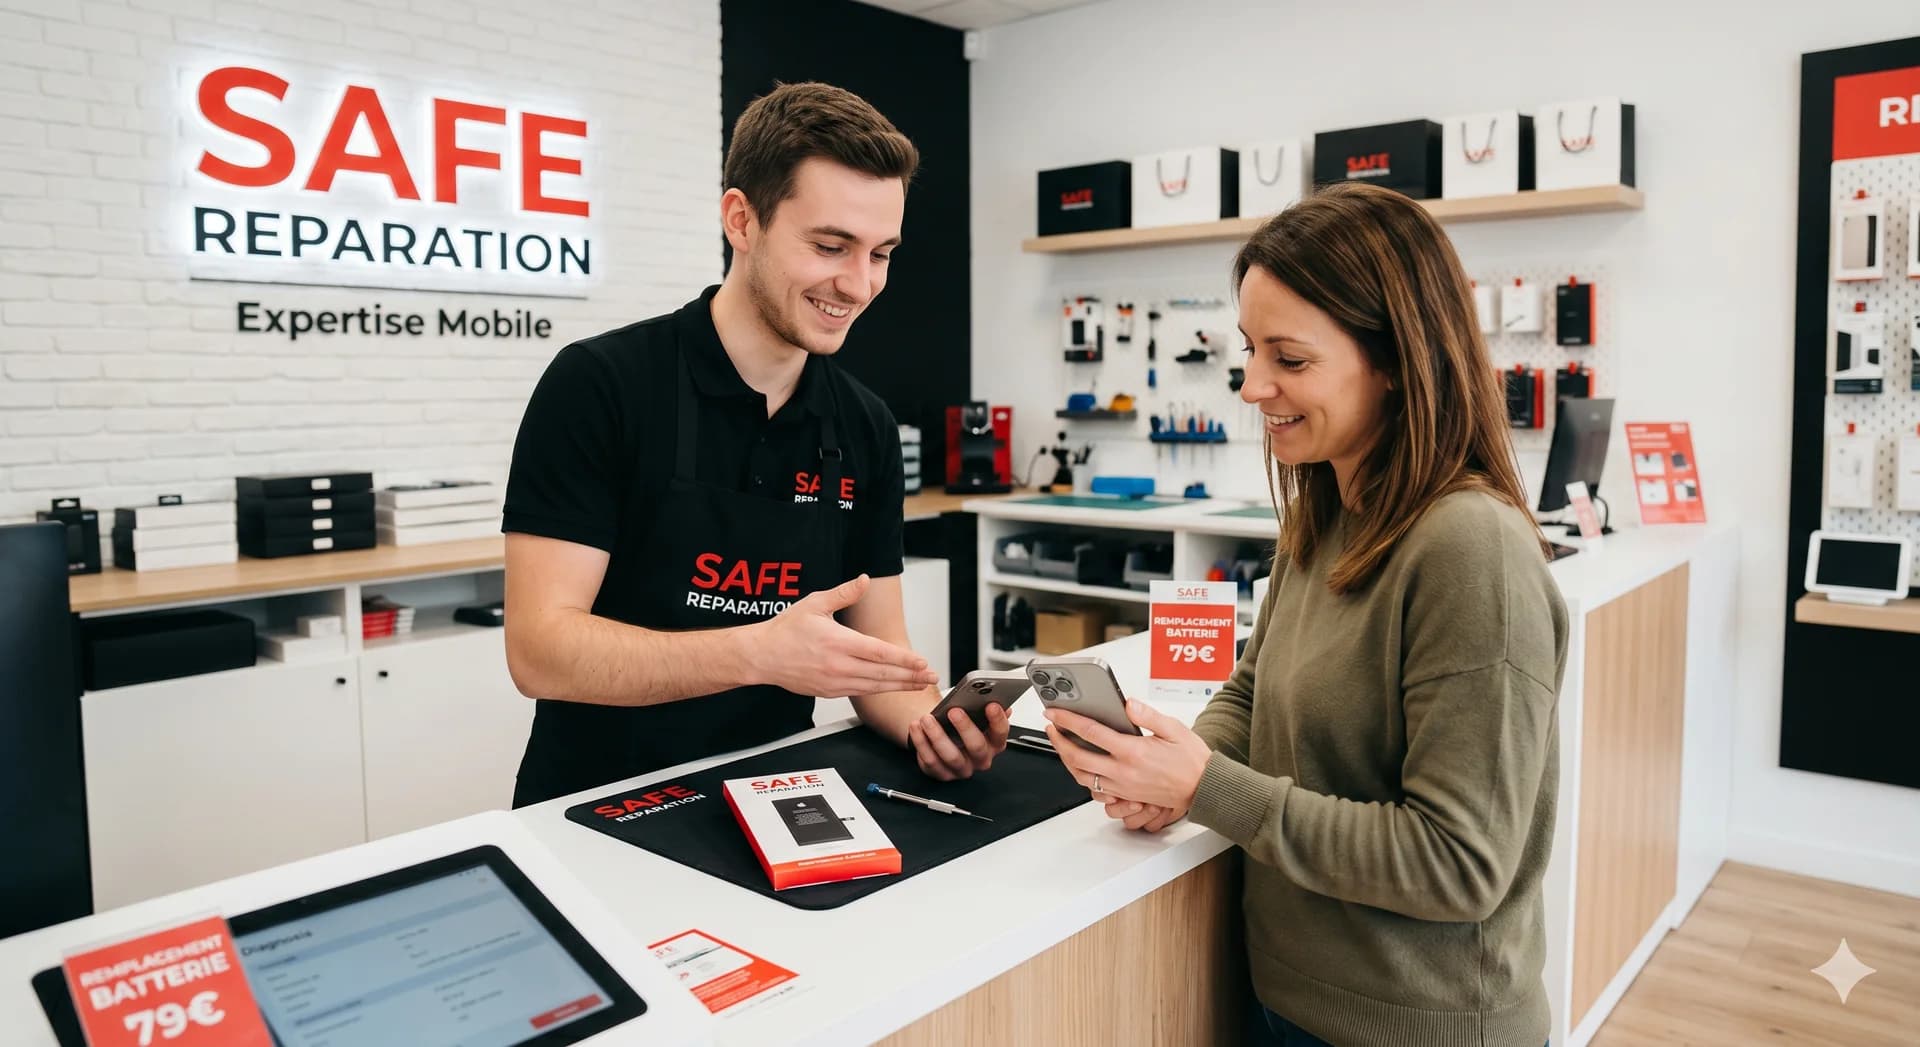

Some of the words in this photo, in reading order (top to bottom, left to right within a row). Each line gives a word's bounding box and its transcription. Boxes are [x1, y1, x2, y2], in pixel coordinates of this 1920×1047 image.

[197, 66, 590, 218] SAFE
[1345, 153, 1390, 171] SAFE
[195, 206, 590, 275] REPARATION
[237, 301, 424, 341] Expertise
[438, 308, 552, 339] Mobile
[795, 472, 855, 499] SAE
[691, 552, 802, 596] SAFE
[1177, 587, 1208, 597] SAFE
[1153, 616, 1232, 628] REMPLACEMENT
[1166, 628, 1219, 639] BATTERIE
[1168, 644, 1216, 663] 79€
[751, 774, 822, 790] SAFE
[756, 783, 825, 795] REPARATION
[593, 785, 697, 818] SAFE
[615, 793, 707, 823] REPARATION
[79, 933, 223, 988] REMPLACEMENT
[89, 951, 231, 1011] BATTERIE
[123, 990, 225, 1047] 79€
